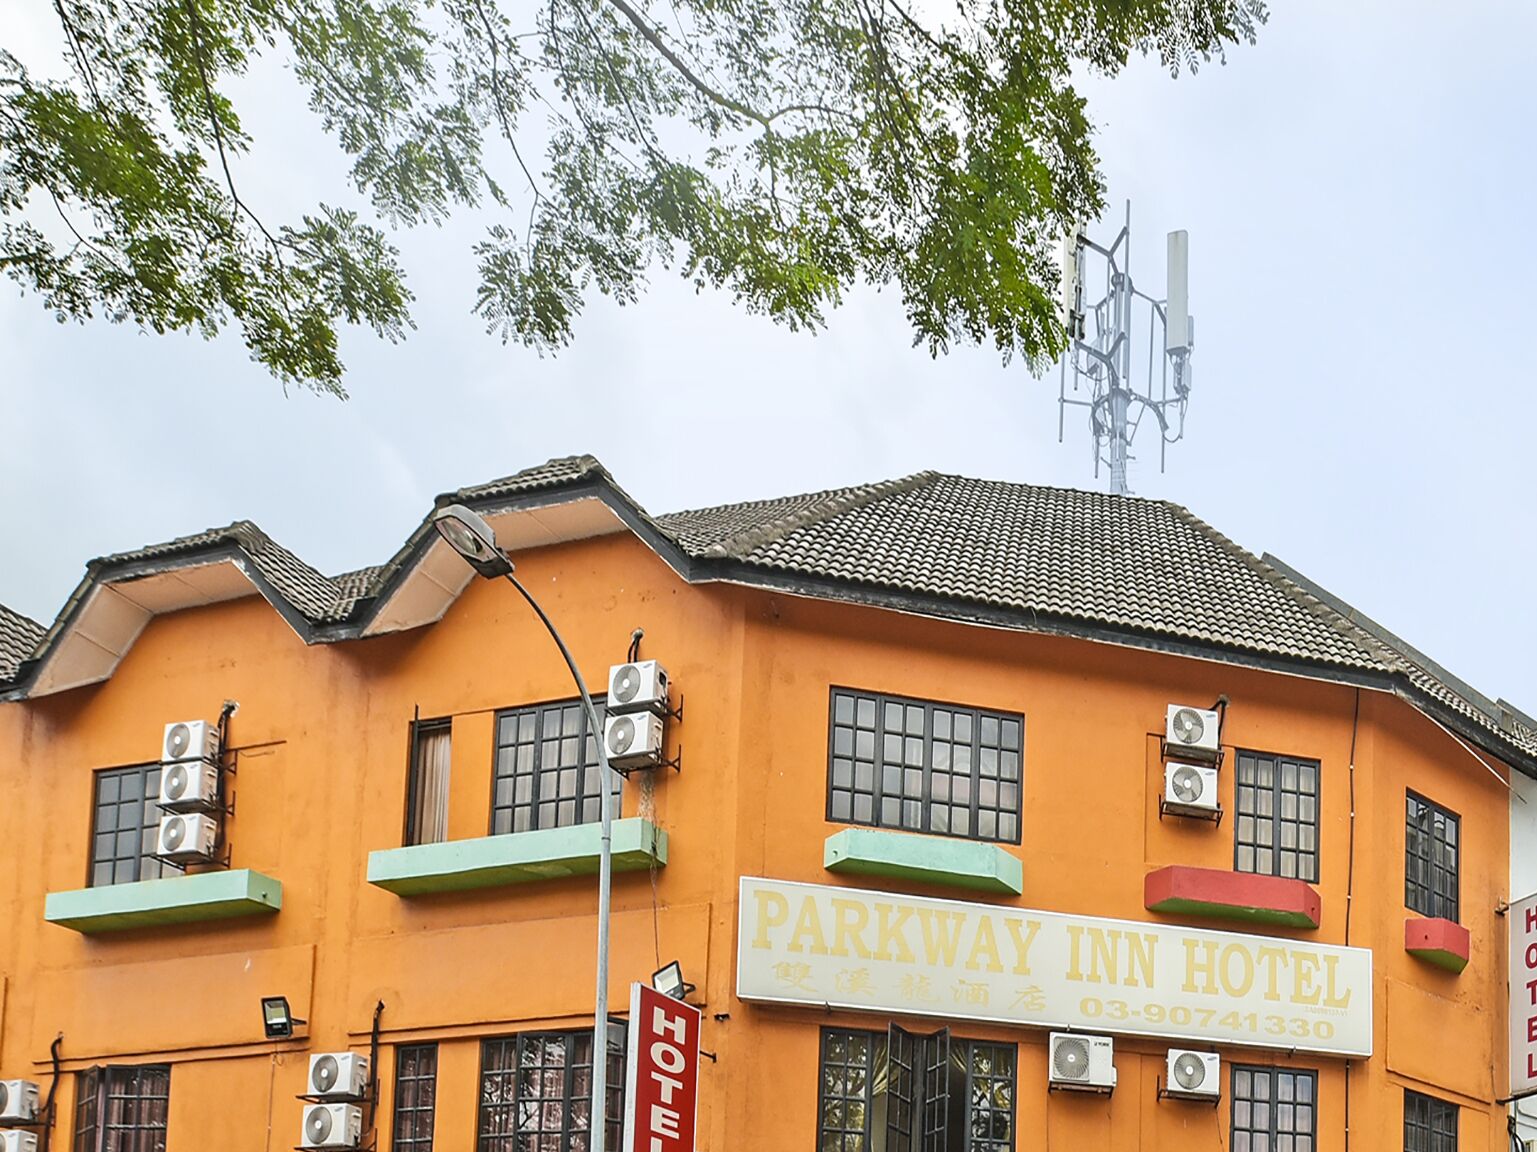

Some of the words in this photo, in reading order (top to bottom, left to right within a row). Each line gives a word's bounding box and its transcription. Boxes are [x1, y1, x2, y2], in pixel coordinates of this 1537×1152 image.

[751, 889, 1042, 977] PARKWAY
[1065, 924, 1159, 989] INN
[1181, 937, 1352, 1010] HOTEL
[1079, 997, 1335, 1041] 03-90741330
